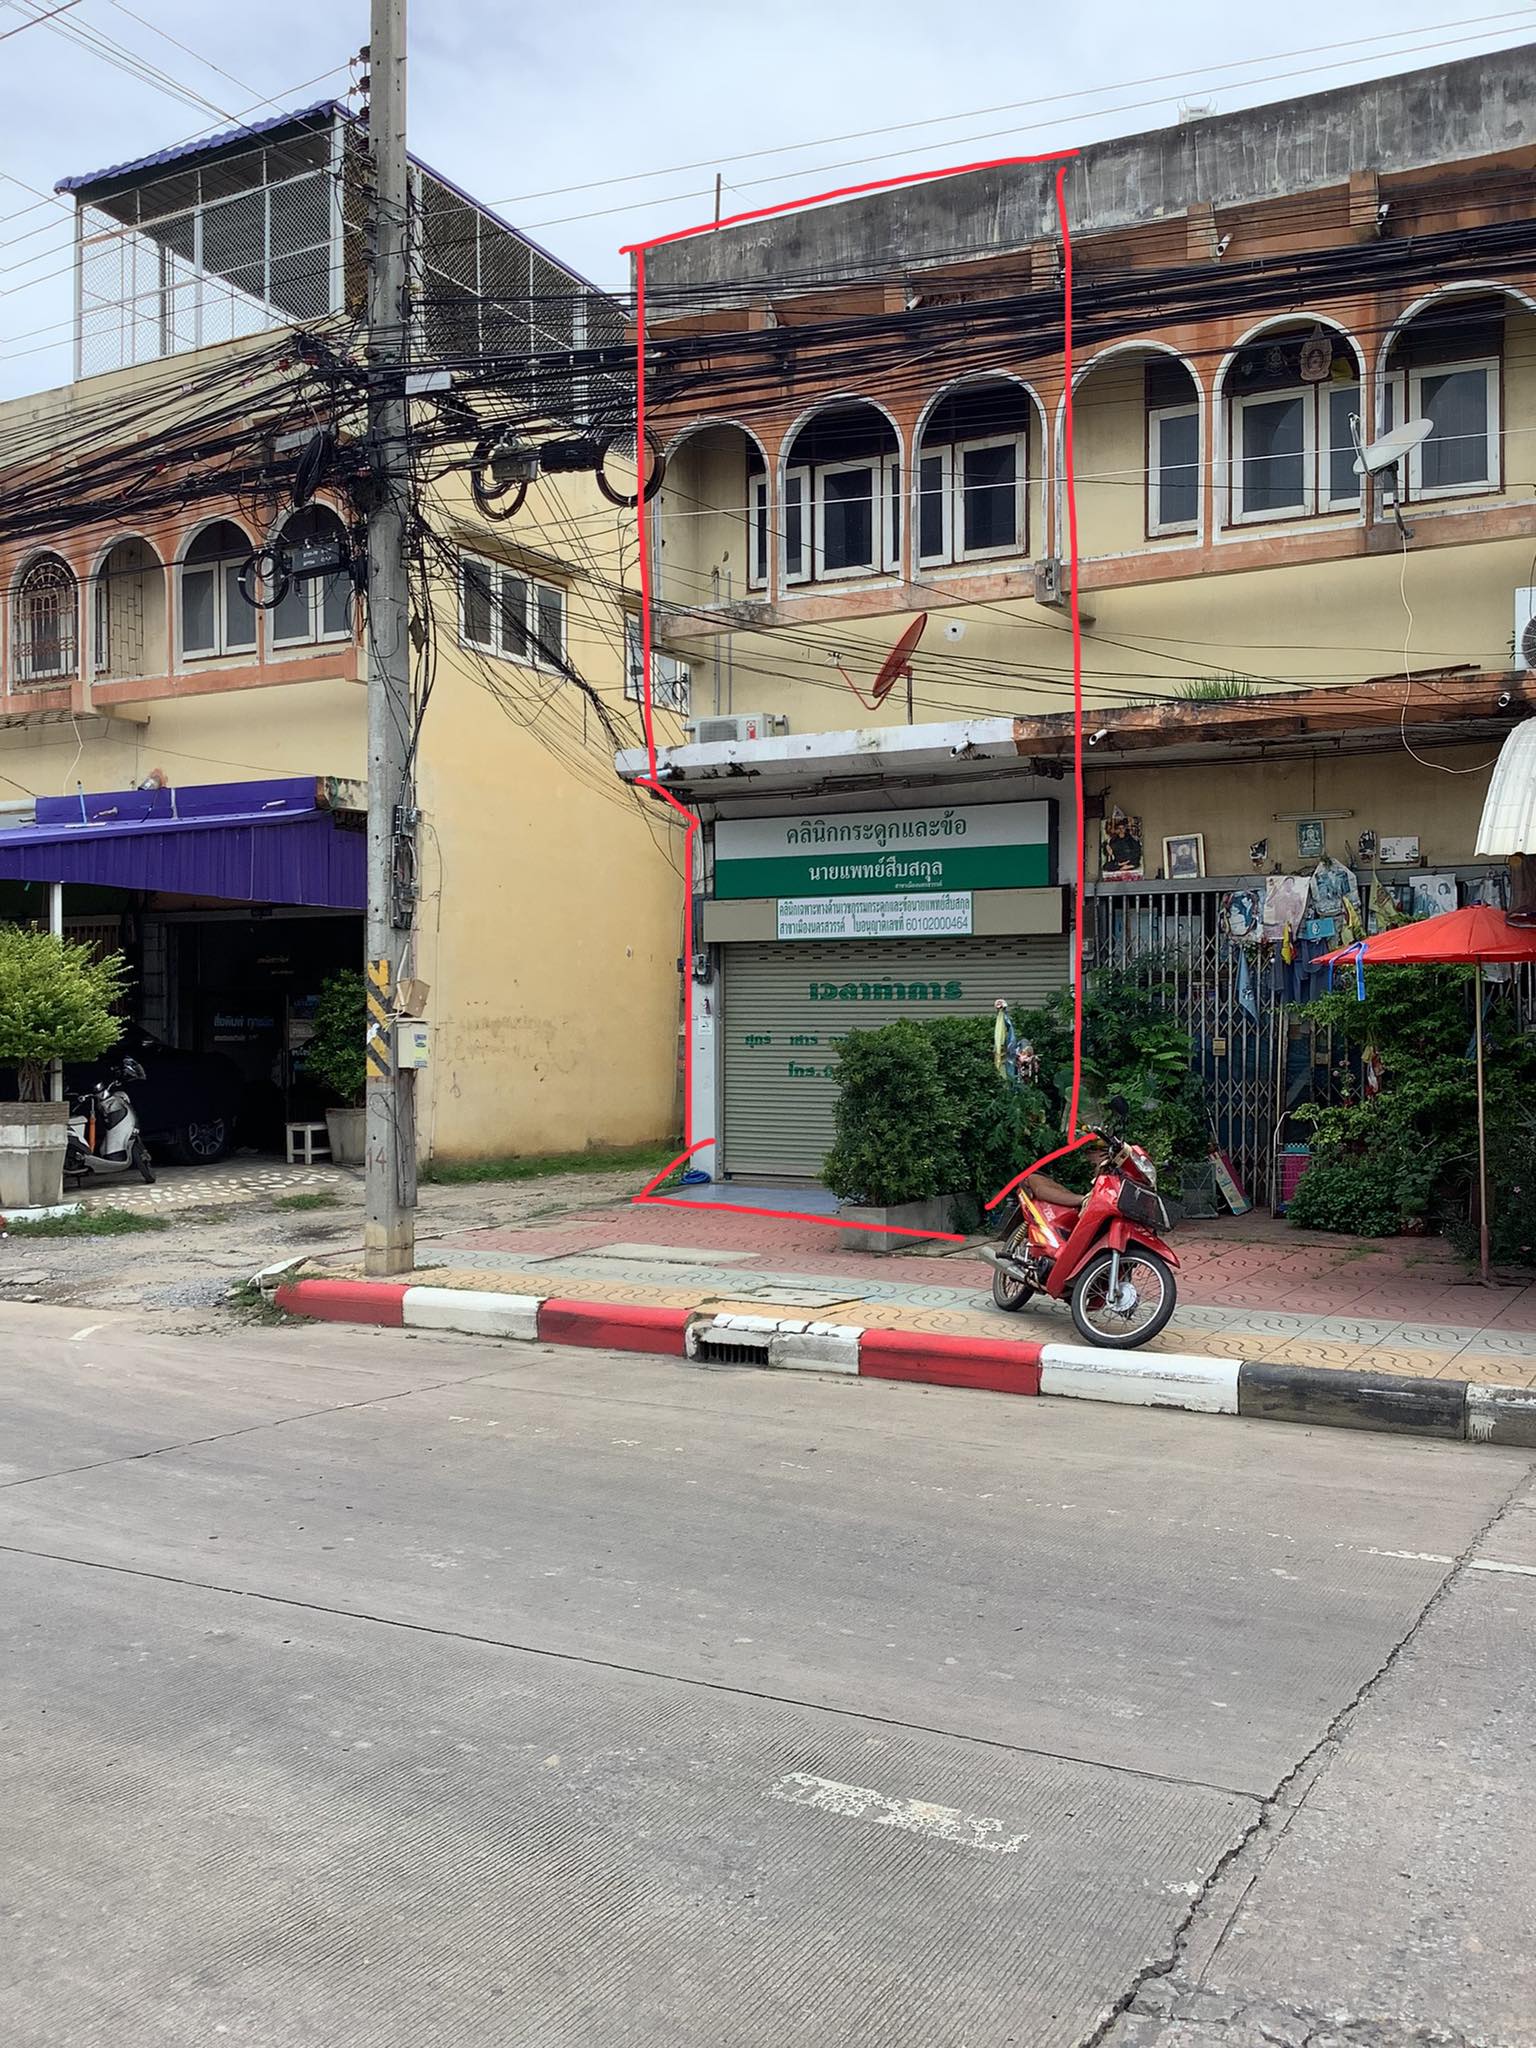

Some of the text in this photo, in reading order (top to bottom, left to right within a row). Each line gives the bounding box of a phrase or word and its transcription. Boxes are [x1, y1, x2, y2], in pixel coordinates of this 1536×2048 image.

[786, 810, 967, 847] คลินิกกระดูกและข้อ
[808, 856, 943, 882] นายแพทย์สืบสกุล
[810, 976, 962, 1000] เวลาทำการ
